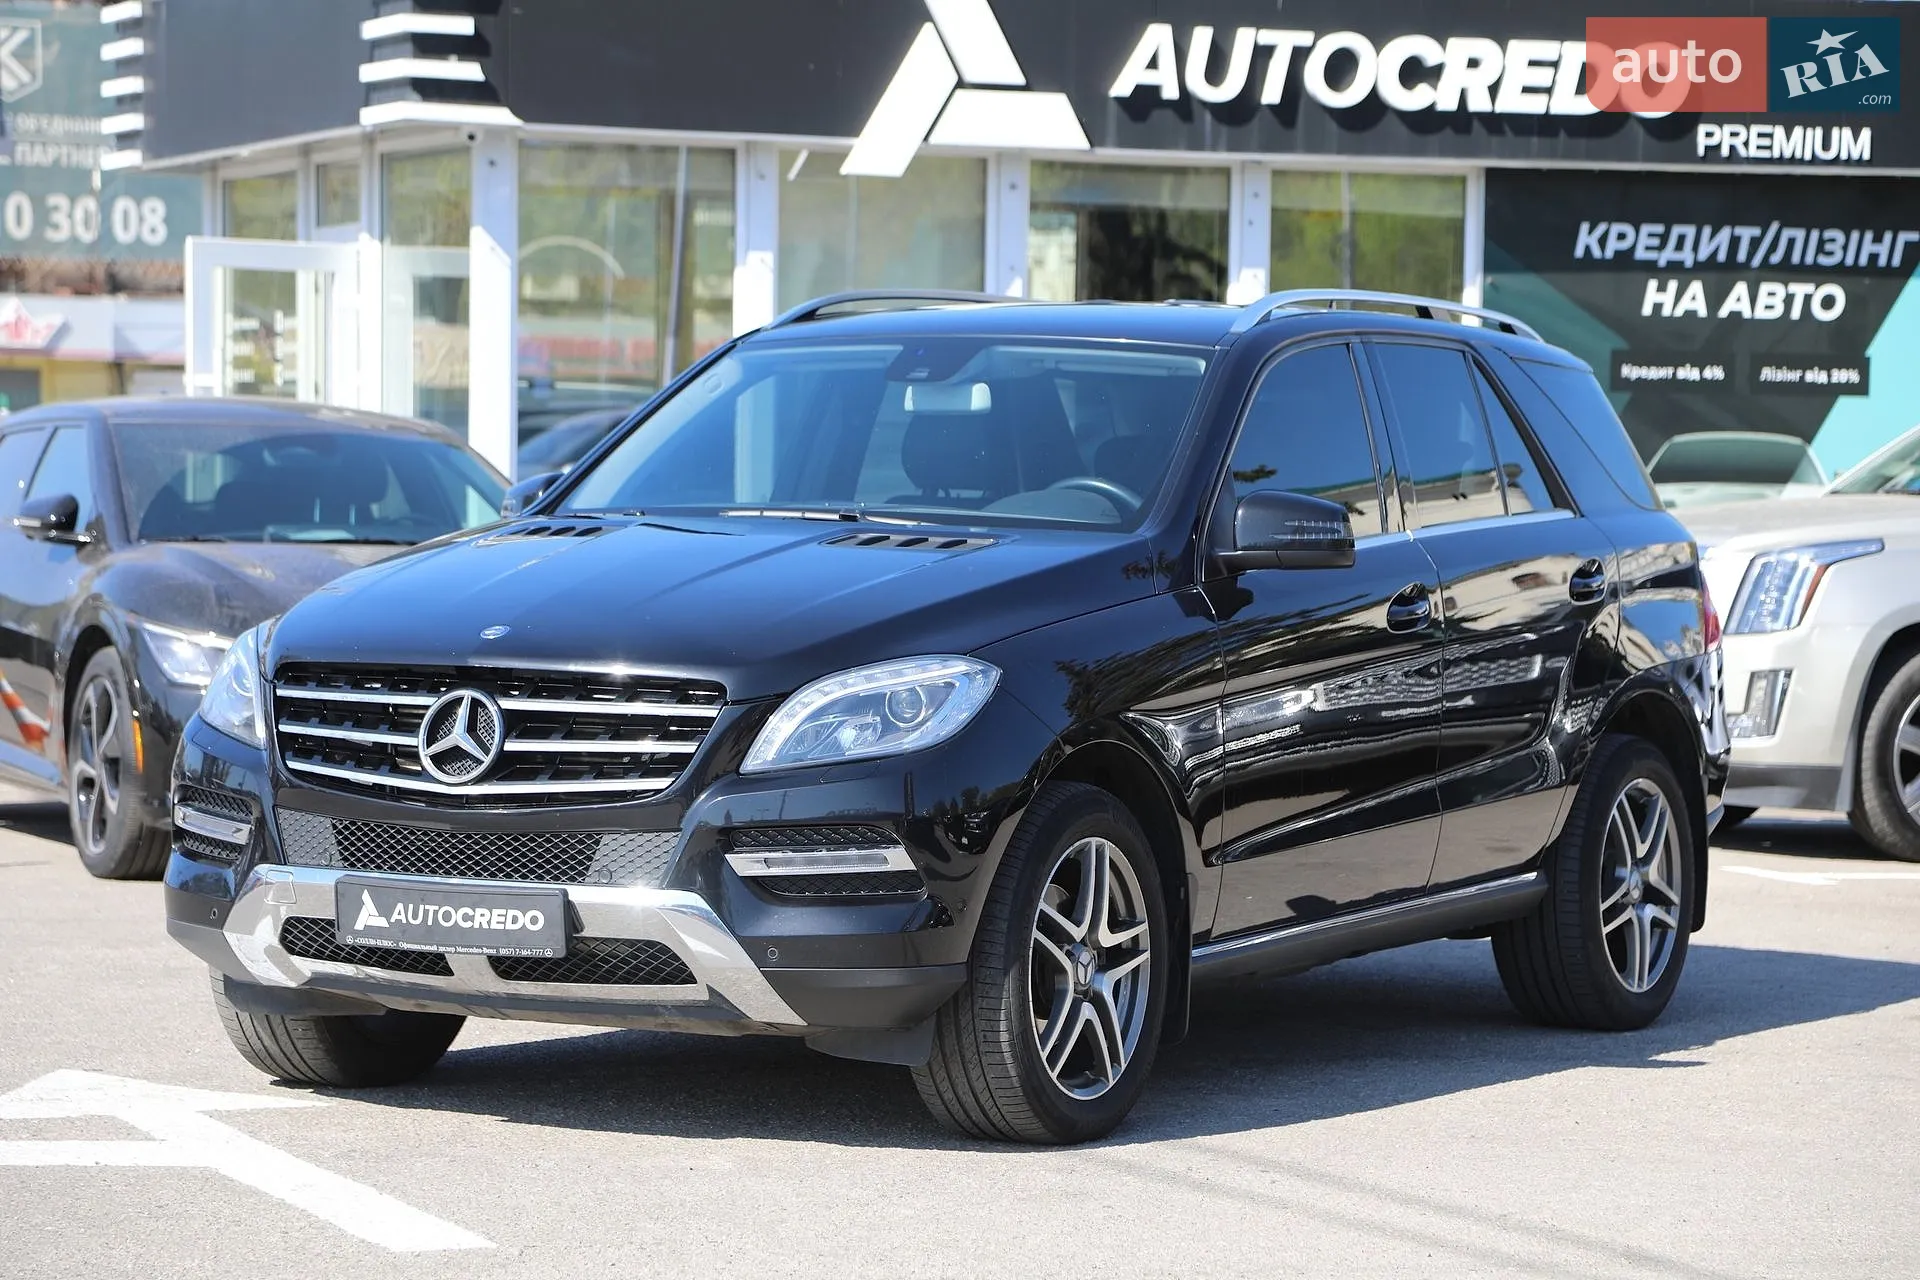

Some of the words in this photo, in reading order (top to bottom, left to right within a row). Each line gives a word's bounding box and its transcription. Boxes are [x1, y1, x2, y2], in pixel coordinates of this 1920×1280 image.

[1109, 22, 1692, 119] AUTOCREDO
[1696, 123, 1872, 161] PREMIUM
[44, 193, 101, 244] 30
[111, 195, 168, 246] 08
[1574, 220, 1919, 269] КРЕДИТ/ЛІЗІНГ
[1641, 278, 1707, 318] НА
[1717, 281, 1846, 322] АВТО
[1620, 363, 1675, 381] Кредит
[390, 902, 545, 931] AUTOCREDO
